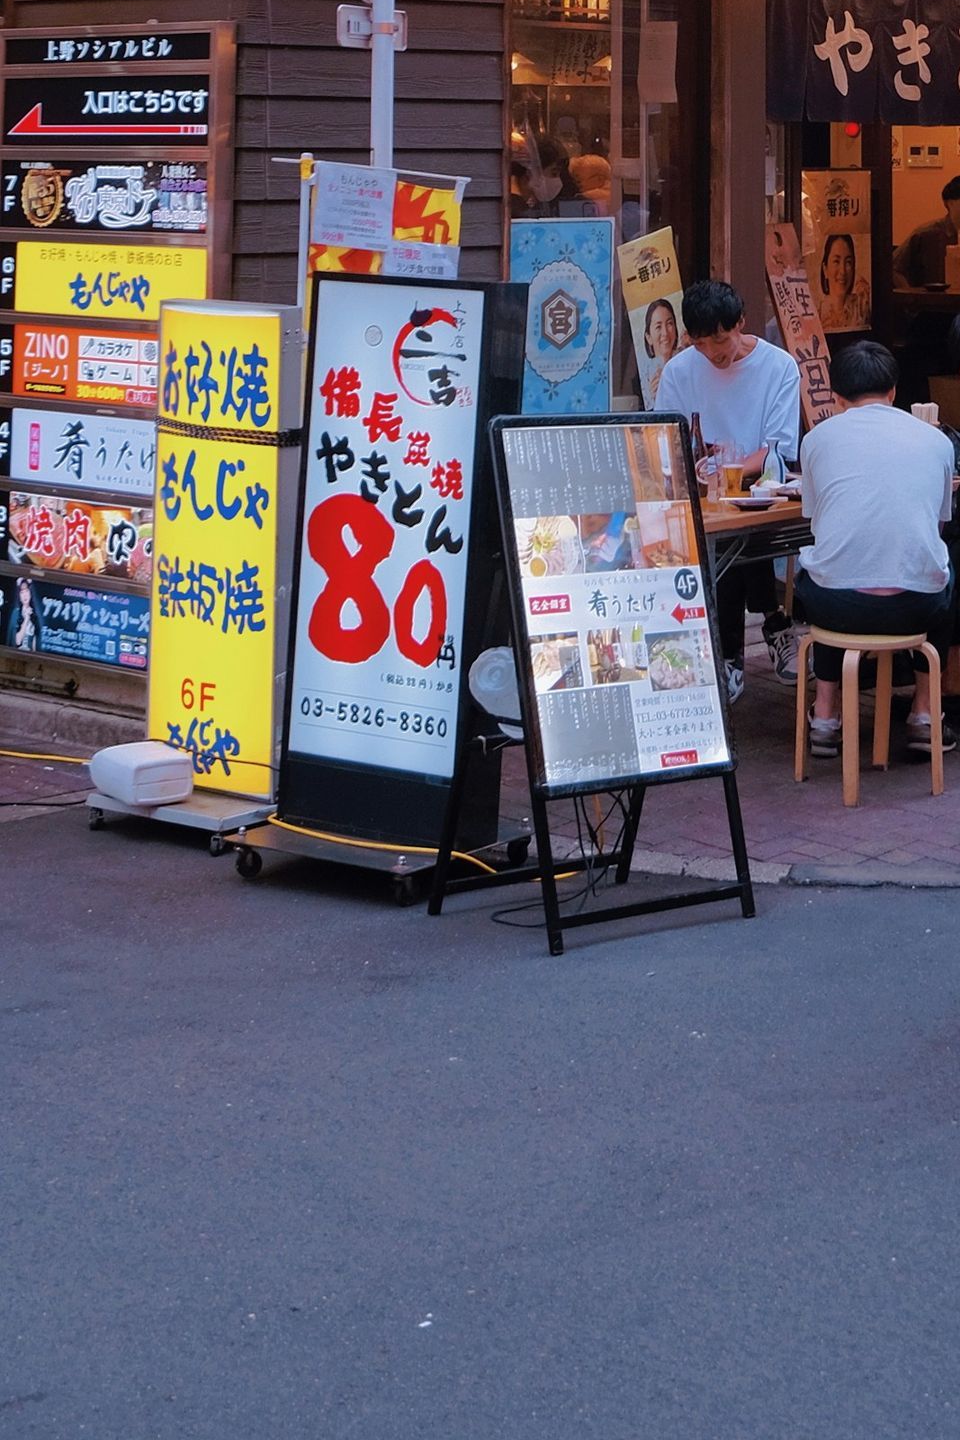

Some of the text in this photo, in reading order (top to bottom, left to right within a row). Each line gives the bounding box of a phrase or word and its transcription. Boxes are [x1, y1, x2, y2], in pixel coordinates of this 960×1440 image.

[42, 38, 173, 63] 上野ソシアルビル
[81, 89, 209, 115] 入口はこちらです
[3, 175, 18, 212] 7F
[1, 256, 16, 295] 6F
[626, 257, 672, 285] 一番搾り
[68, 271, 150, 313] もんじゃや
[24, 332, 70, 360] ZINO
[97, 341, 134, 357] カラオケ
[96, 363, 134, 381] ゲーム
[161, 339, 272, 428] お好焼
[795, 334, 838, 426] 営
[319, 363, 465, 501] 備長炭焼
[160, 448, 270, 530] もんじゃ
[316, 430, 465, 556] やきとん
[25, 505, 91, 563] 焼肉
[156, 553, 267, 635] 鉄板焼
[587, 587, 657, 619] 肴うたげ
[676, 574, 698, 595] 4F
[531, 597, 568, 613] 完全個室
[179, 677, 217, 713] 6F
[300, 695, 448, 739] 03-5826-8360
